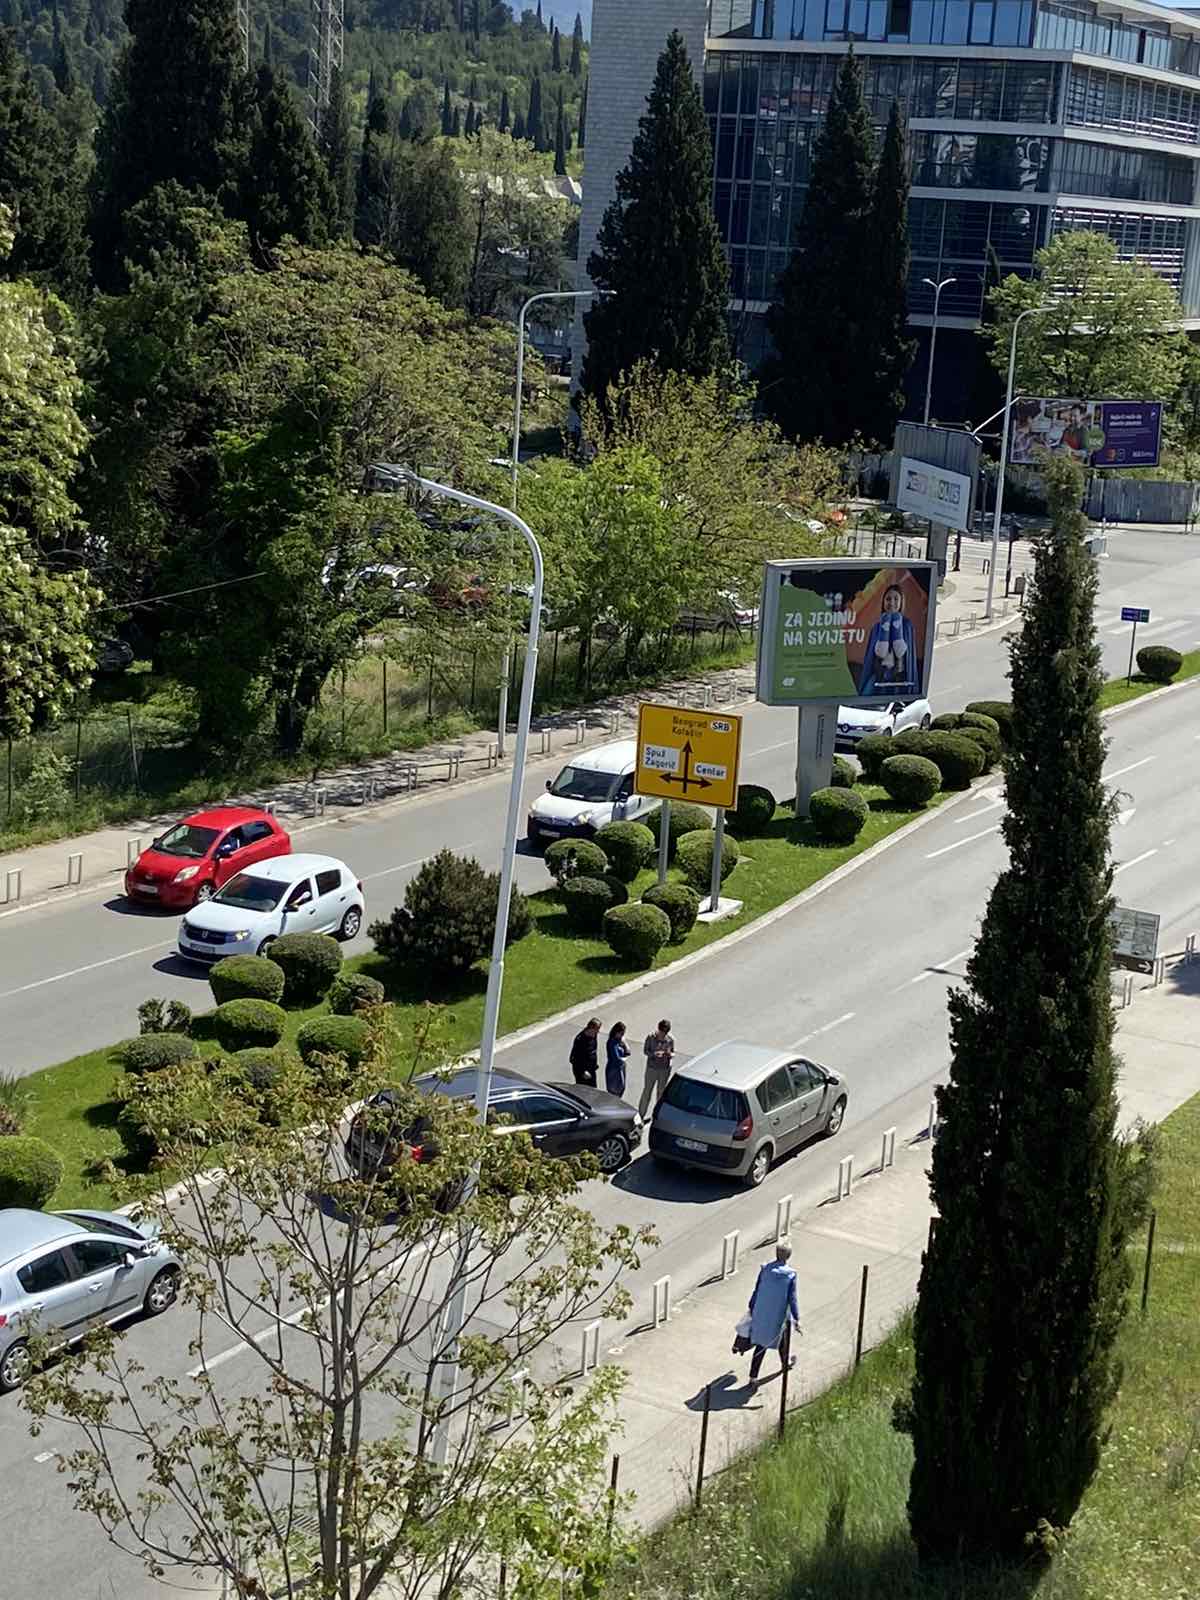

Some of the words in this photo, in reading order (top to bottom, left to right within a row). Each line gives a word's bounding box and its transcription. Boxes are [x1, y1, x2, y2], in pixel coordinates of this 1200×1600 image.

[784, 612, 803, 628] ZA
[807, 610, 856, 626] JEDINU
[783, 630, 803, 646] NA
[807, 629, 865, 645] SVIJETU
[712, 721, 730, 732] SRB
